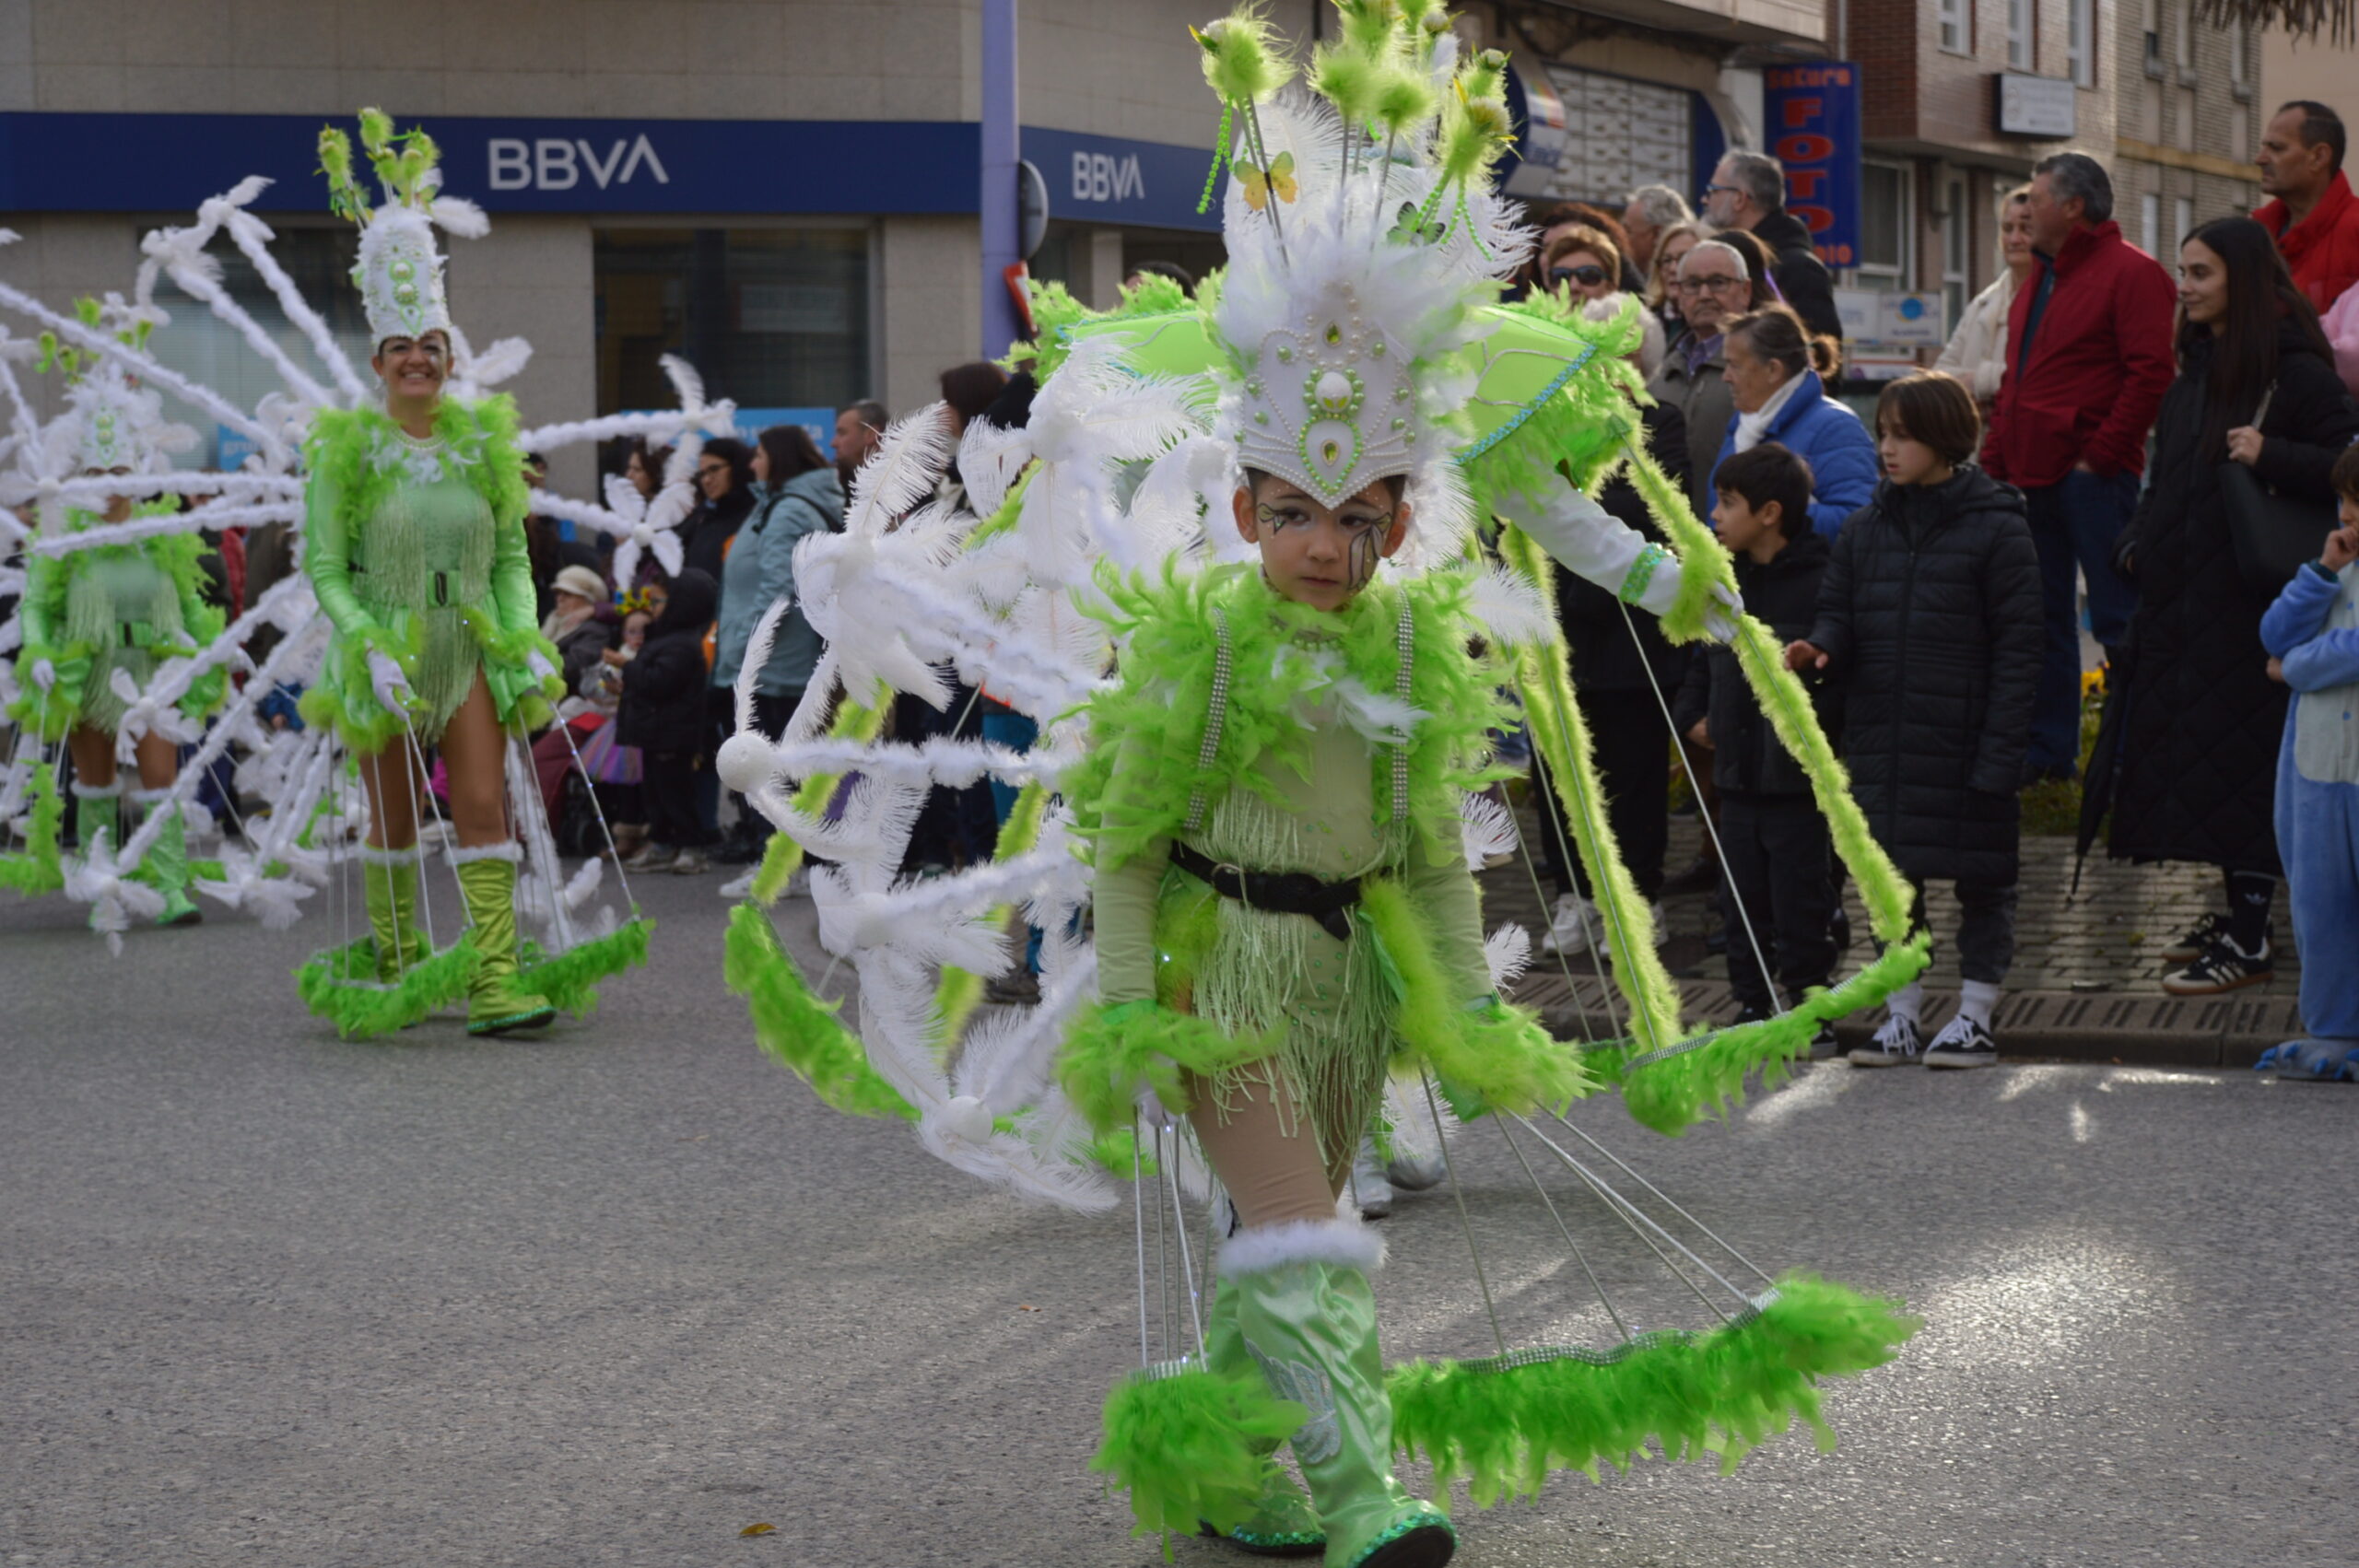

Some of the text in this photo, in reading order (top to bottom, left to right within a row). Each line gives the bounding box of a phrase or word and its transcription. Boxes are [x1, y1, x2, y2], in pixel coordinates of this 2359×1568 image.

[488, 134, 670, 190] BBVA
[1073, 151, 1145, 203] BBVA
[1776, 97, 1835, 234] FOTO
